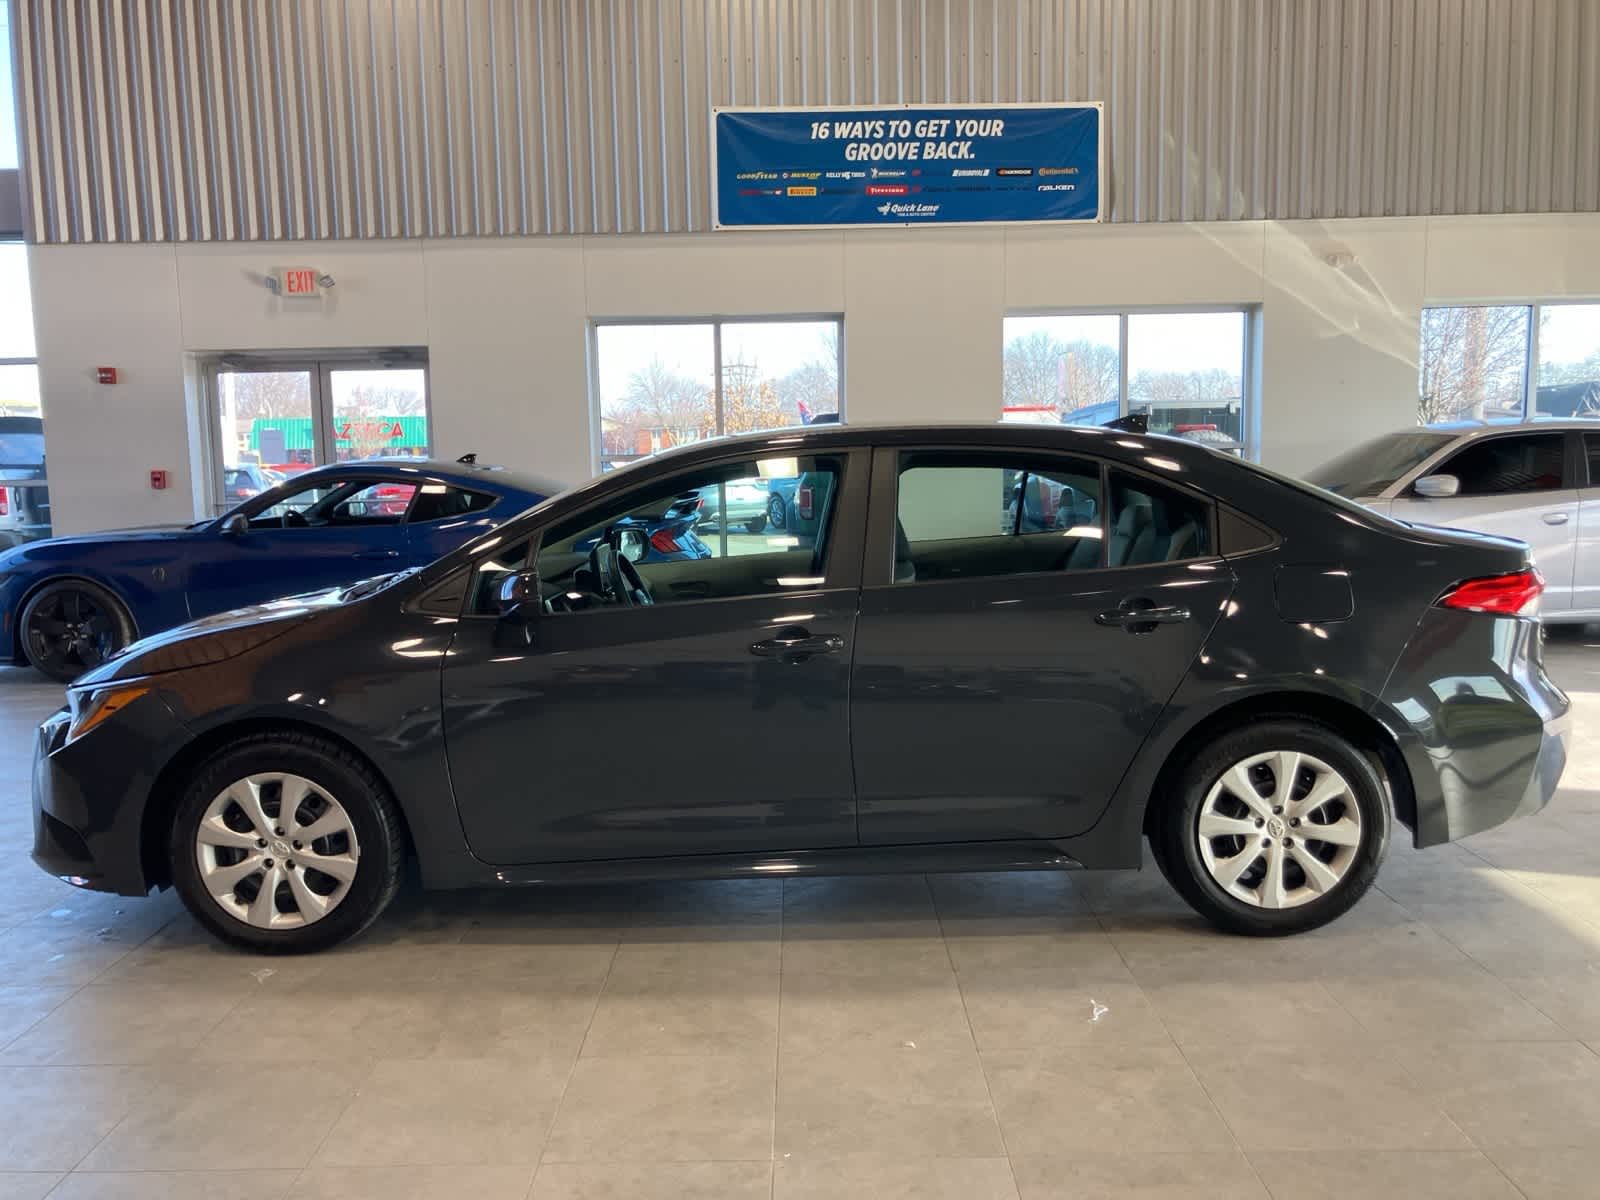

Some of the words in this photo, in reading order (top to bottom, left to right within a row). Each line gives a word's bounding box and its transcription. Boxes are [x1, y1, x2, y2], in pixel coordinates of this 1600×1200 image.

[811, 122, 829, 139] 16
[834, 121, 885, 139] WAYS
[889, 120, 911, 138] TO
[915, 120, 950, 137] GET
[955, 119, 1004, 137] YOUR
[845, 142, 920, 161] GROOVE
[923, 141, 976, 160] BACK.
[1038, 184, 1075, 192] FALKEN
[891, 203, 916, 213] Quick
[917, 203, 940, 212] Lane
[287, 271, 315, 292] EXIT
